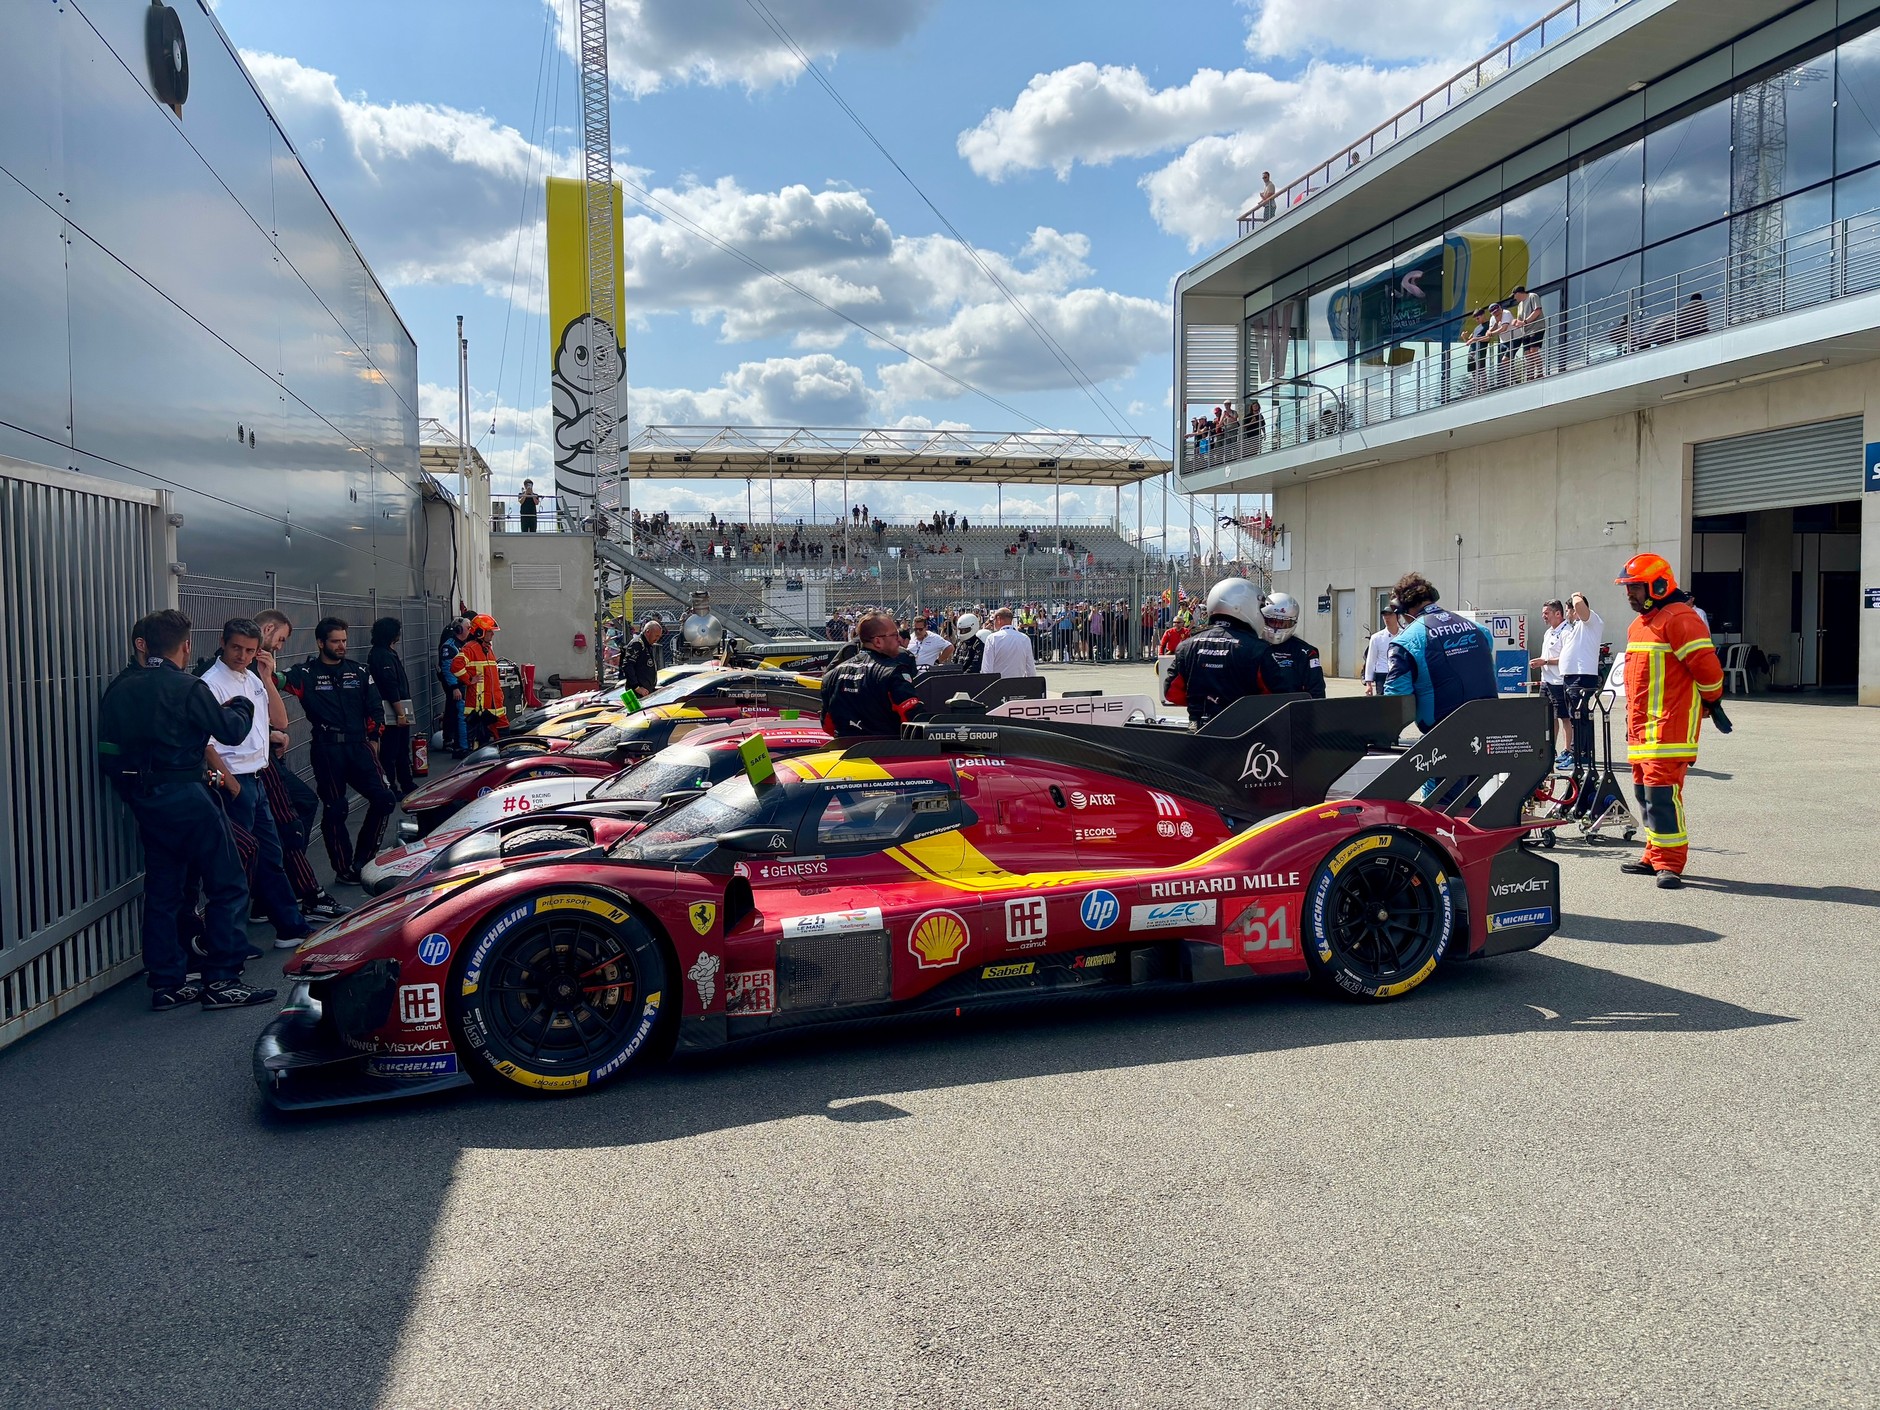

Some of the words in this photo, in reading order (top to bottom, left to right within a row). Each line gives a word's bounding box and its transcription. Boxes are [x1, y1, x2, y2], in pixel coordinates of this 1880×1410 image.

[1429, 621, 1477, 638] OFFICIAL
[1443, 633, 1477, 649] WEC
[1008, 702, 1123, 718] PORSCHE
[927, 732, 957, 741] ADLER
[969, 731, 998, 740] GROUP
[750, 752, 767, 767] SAFE
[955, 757, 1006, 768] Cetilar
[1244, 781, 1283, 789] ESPRESSO
[503, 795, 531, 812] #6
[1089, 794, 1116, 806] AT&T
[1084, 828, 1117, 838] ECOPOL
[1378, 837, 1388, 845] M
[771, 862, 829, 878] GENESYS
[1151, 876, 1237, 897] RICHARD
[1243, 872, 1300, 889] MILLE
[1491, 877, 1550, 897] VISTAJET
[541, 898, 564, 907] PILOT
[565, 897, 592, 907] SPORT
[1314, 875, 1331, 939] MICHELIN
[608, 909, 624, 921] M
[1086, 890, 1114, 931] hp
[1148, 902, 1201, 920] WEC
[1437, 895, 1452, 957] MICHELIN
[1502, 911, 1546, 926] MICHELIN
[472, 905, 528, 966] MICHELIN
[1244, 905, 1293, 952] 51
[423, 933, 447, 965] hp
[1020, 940, 1047, 949] azimut
[988, 964, 1029, 978] Sabelt
[415, 1022, 442, 1032] azimut
[384, 1038, 449, 1052] VISTAJET
[597, 1019, 651, 1079] MICHELIN
[531, 1078, 559, 1088] SPORT
[559, 1077, 583, 1087] PILOT
